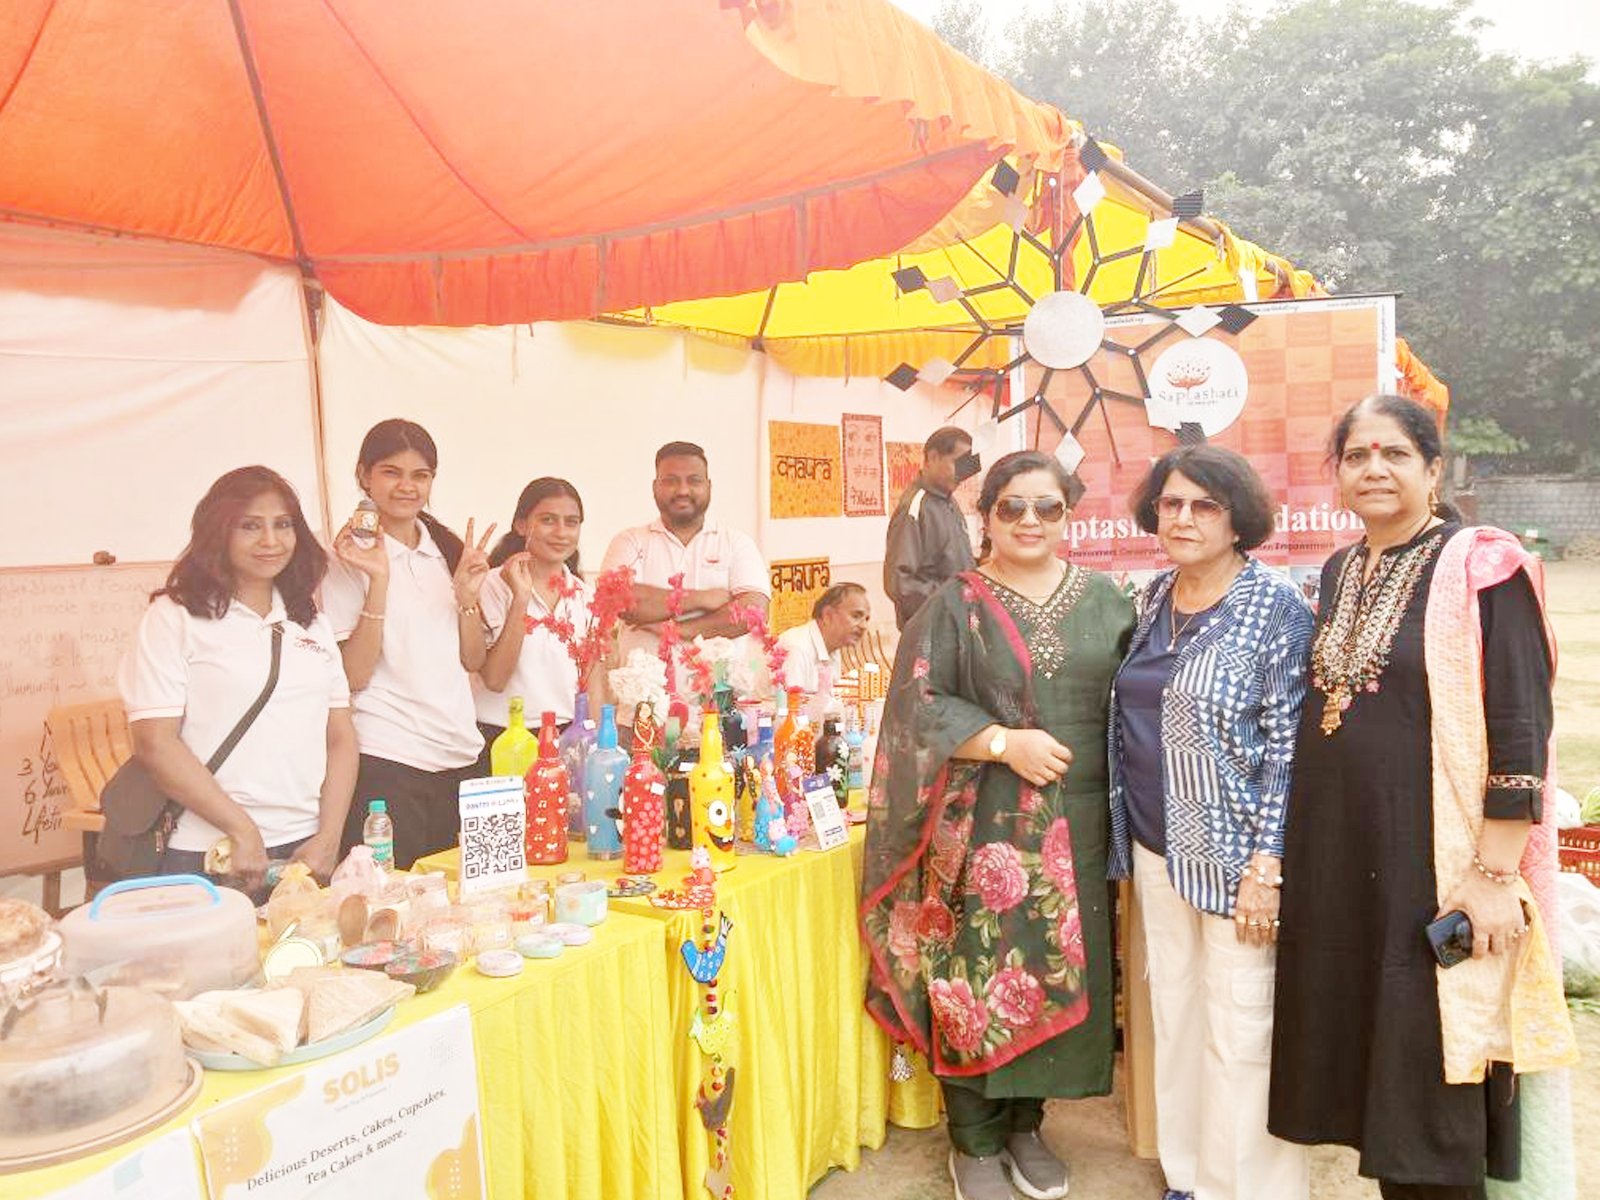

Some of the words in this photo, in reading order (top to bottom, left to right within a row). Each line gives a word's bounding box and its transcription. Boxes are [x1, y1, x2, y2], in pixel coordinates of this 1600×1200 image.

[323, 1052, 400, 1105] SOLIS
[247, 1157, 308, 1191] Delicious
[310, 1132, 360, 1163] Deserts,
[306, 1169, 327, 1185] Tea
[329, 1149, 364, 1174] Cakes
[365, 1143, 375, 1155] &
[376, 1128, 408, 1151] more.
